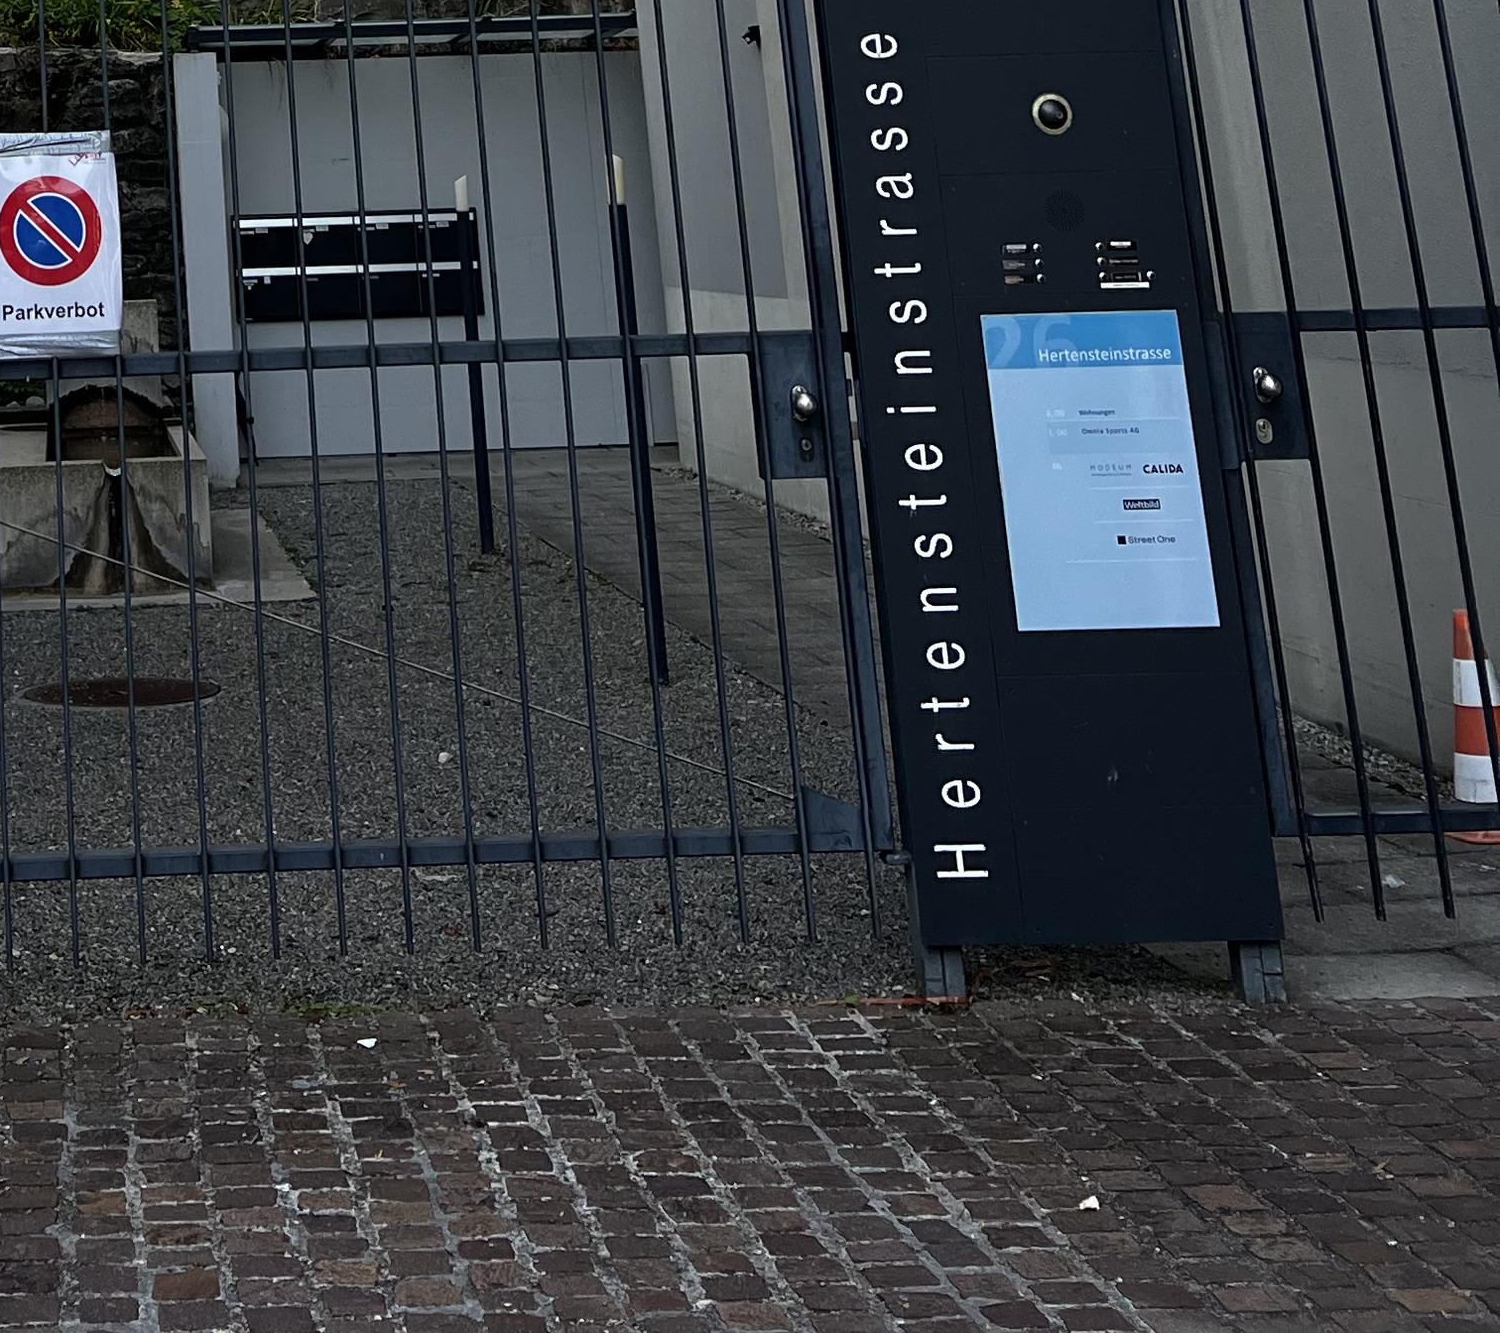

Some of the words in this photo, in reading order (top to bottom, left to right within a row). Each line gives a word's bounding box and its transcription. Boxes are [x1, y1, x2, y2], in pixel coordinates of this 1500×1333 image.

[2, 301, 105, 321] Parkverbot
[1038, 346, 1172, 363] Hertensteinstrasse
[1078, 409, 1116, 417] Wohnungen
[1105, 427, 1129, 436] Sports
[860, 32, 989, 879] Hertensteinstrasse
[1142, 463, 1185, 475] CALIDA
[1123, 499, 1160, 510] Weltbild
[1128, 535, 1156, 545] Street
[1157, 534, 1176, 544] One
